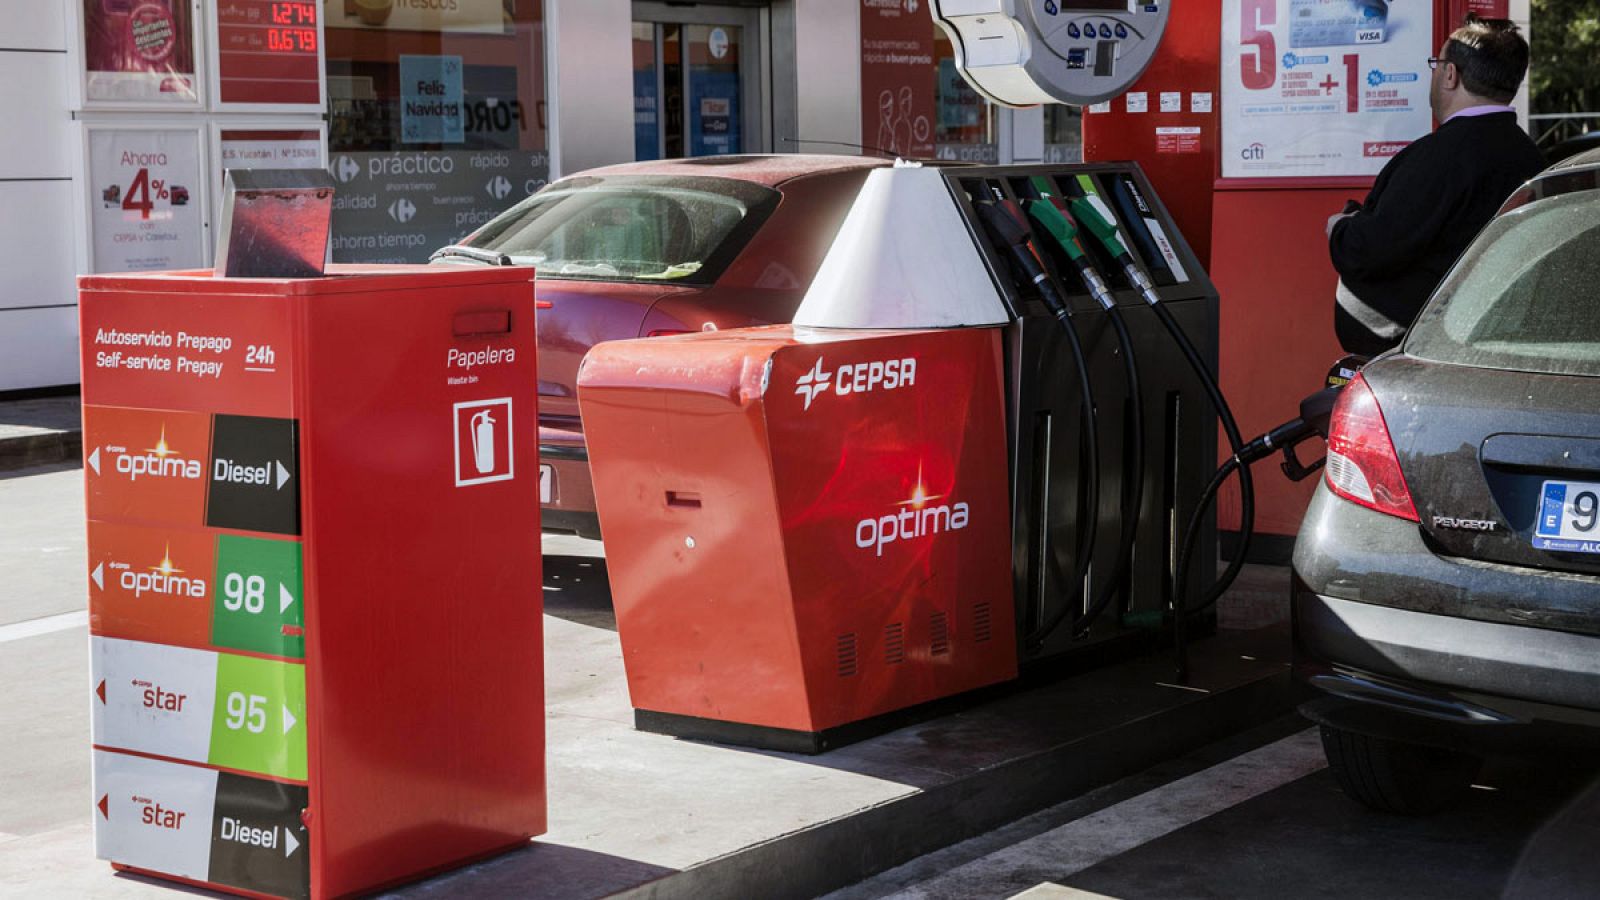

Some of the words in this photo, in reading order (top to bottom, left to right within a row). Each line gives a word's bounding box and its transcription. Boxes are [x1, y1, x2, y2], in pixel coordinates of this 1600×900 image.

[272, 3, 316, 24] 1.274
[267, 29, 316, 51] 0.679
[1360, 32, 1381, 41] VISA
[417, 81, 446, 96] Feliz
[406, 102, 459, 117] Navidad
[120, 151, 168, 166] Ahorra
[470, 152, 509, 169] rápido
[1241, 146, 1264, 160] citi
[368, 152, 454, 181] práctico
[379, 232, 426, 249] tiempo
[95, 327, 172, 348] Autoservicio
[177, 331, 231, 353] Prepago
[96, 351, 171, 371] Self-service
[176, 356, 223, 378] Prepay
[245, 345, 275, 364] 24h
[447, 345, 516, 371] Papelera
[835, 357, 917, 396] CEPSA
[116, 453, 201, 481] optima
[214, 458, 272, 485] Diesel
[855, 502, 969, 557] optima
[1432, 515, 1497, 531] PEUGEOT
[1545, 515, 1556, 528] E
[120, 570, 206, 598] optima
[223, 571, 266, 615] 98
[143, 687, 187, 713] star
[226, 691, 267, 734] 95
[142, 803, 186, 830] star
[220, 816, 279, 849] Diesel
